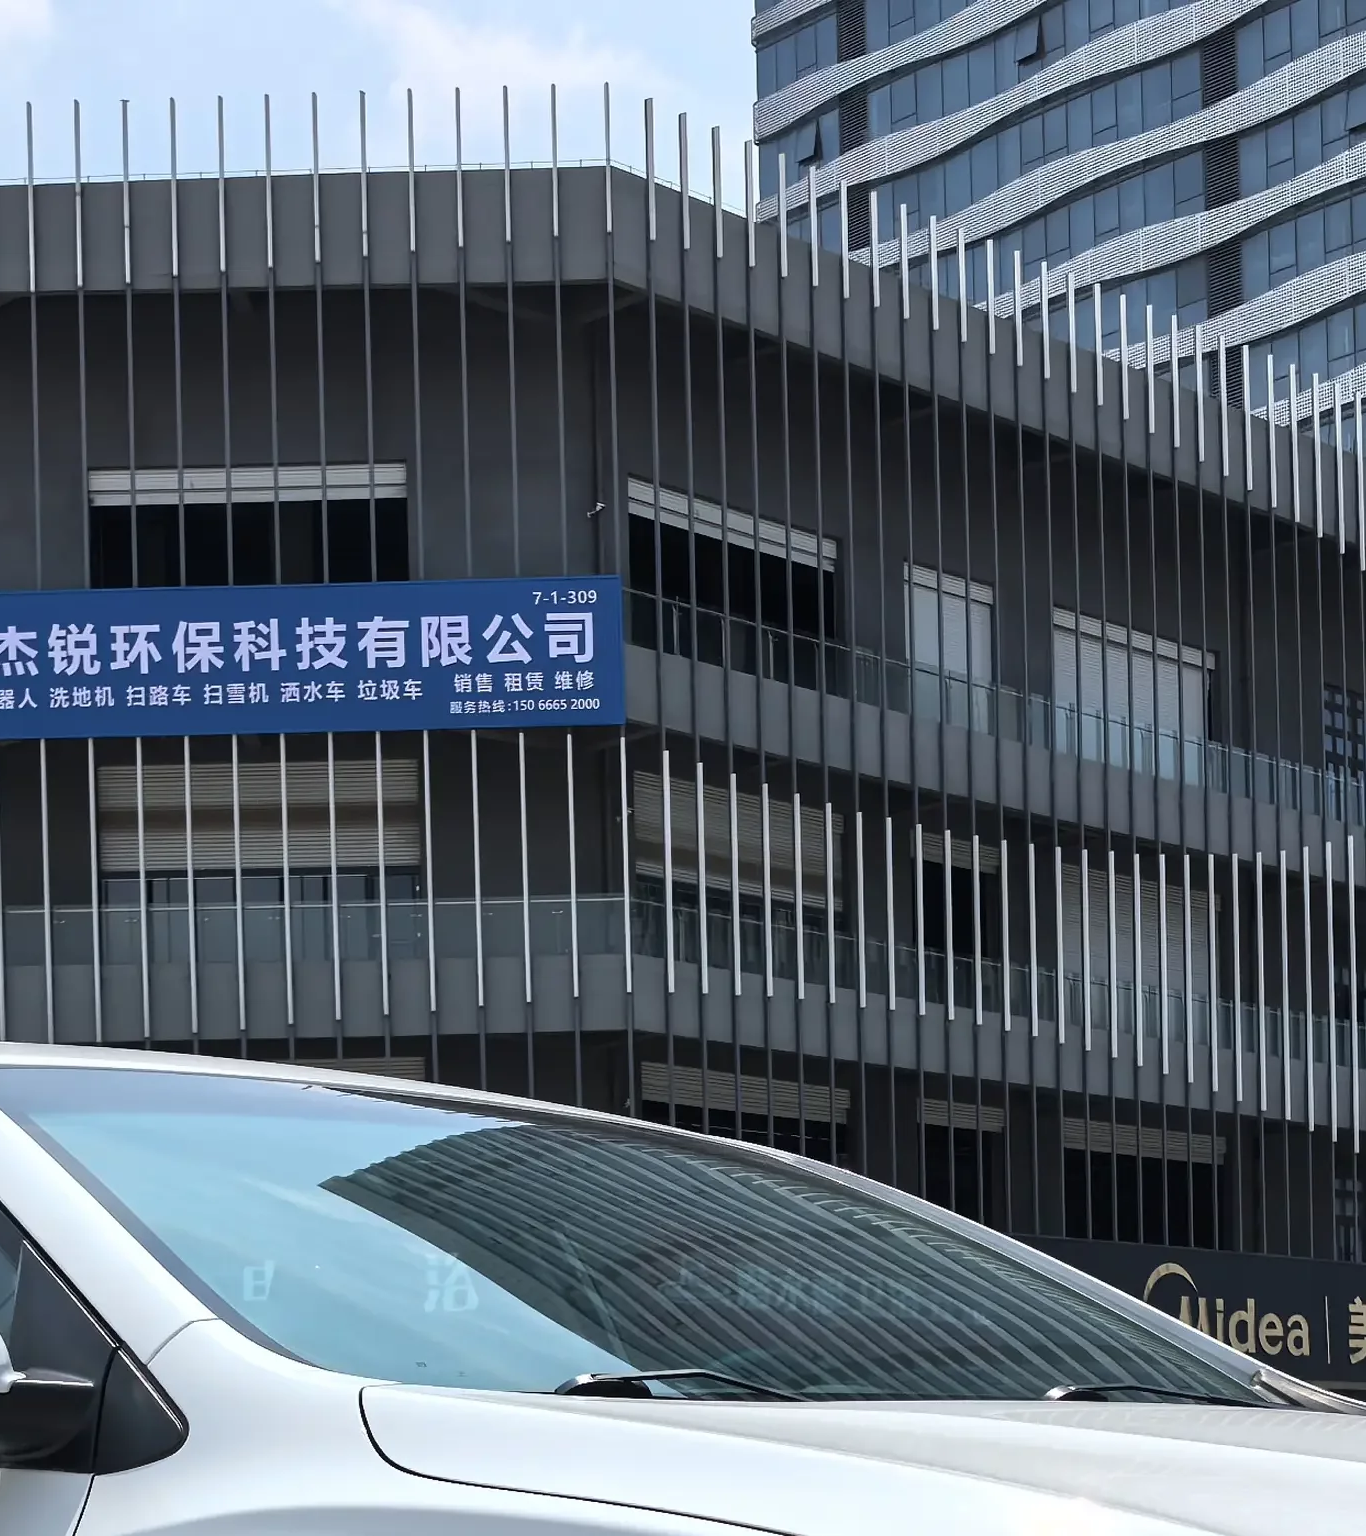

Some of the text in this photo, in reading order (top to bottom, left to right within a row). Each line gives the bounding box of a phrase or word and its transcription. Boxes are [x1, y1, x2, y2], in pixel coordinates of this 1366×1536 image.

[532, 589, 597, 605] 7-1-309
[453, 669, 595, 693] 销售 租赁 维修
[49, 686, 115, 708] 洗地机
[126, 684, 192, 707] 扫路车
[203, 682, 269, 705] 扫雪机
[280, 680, 346, 703] 洒水车
[357, 678, 423, 701] 垃圾车
[538, 698, 568, 712] 6665
[570, 698, 600, 711] 2000
